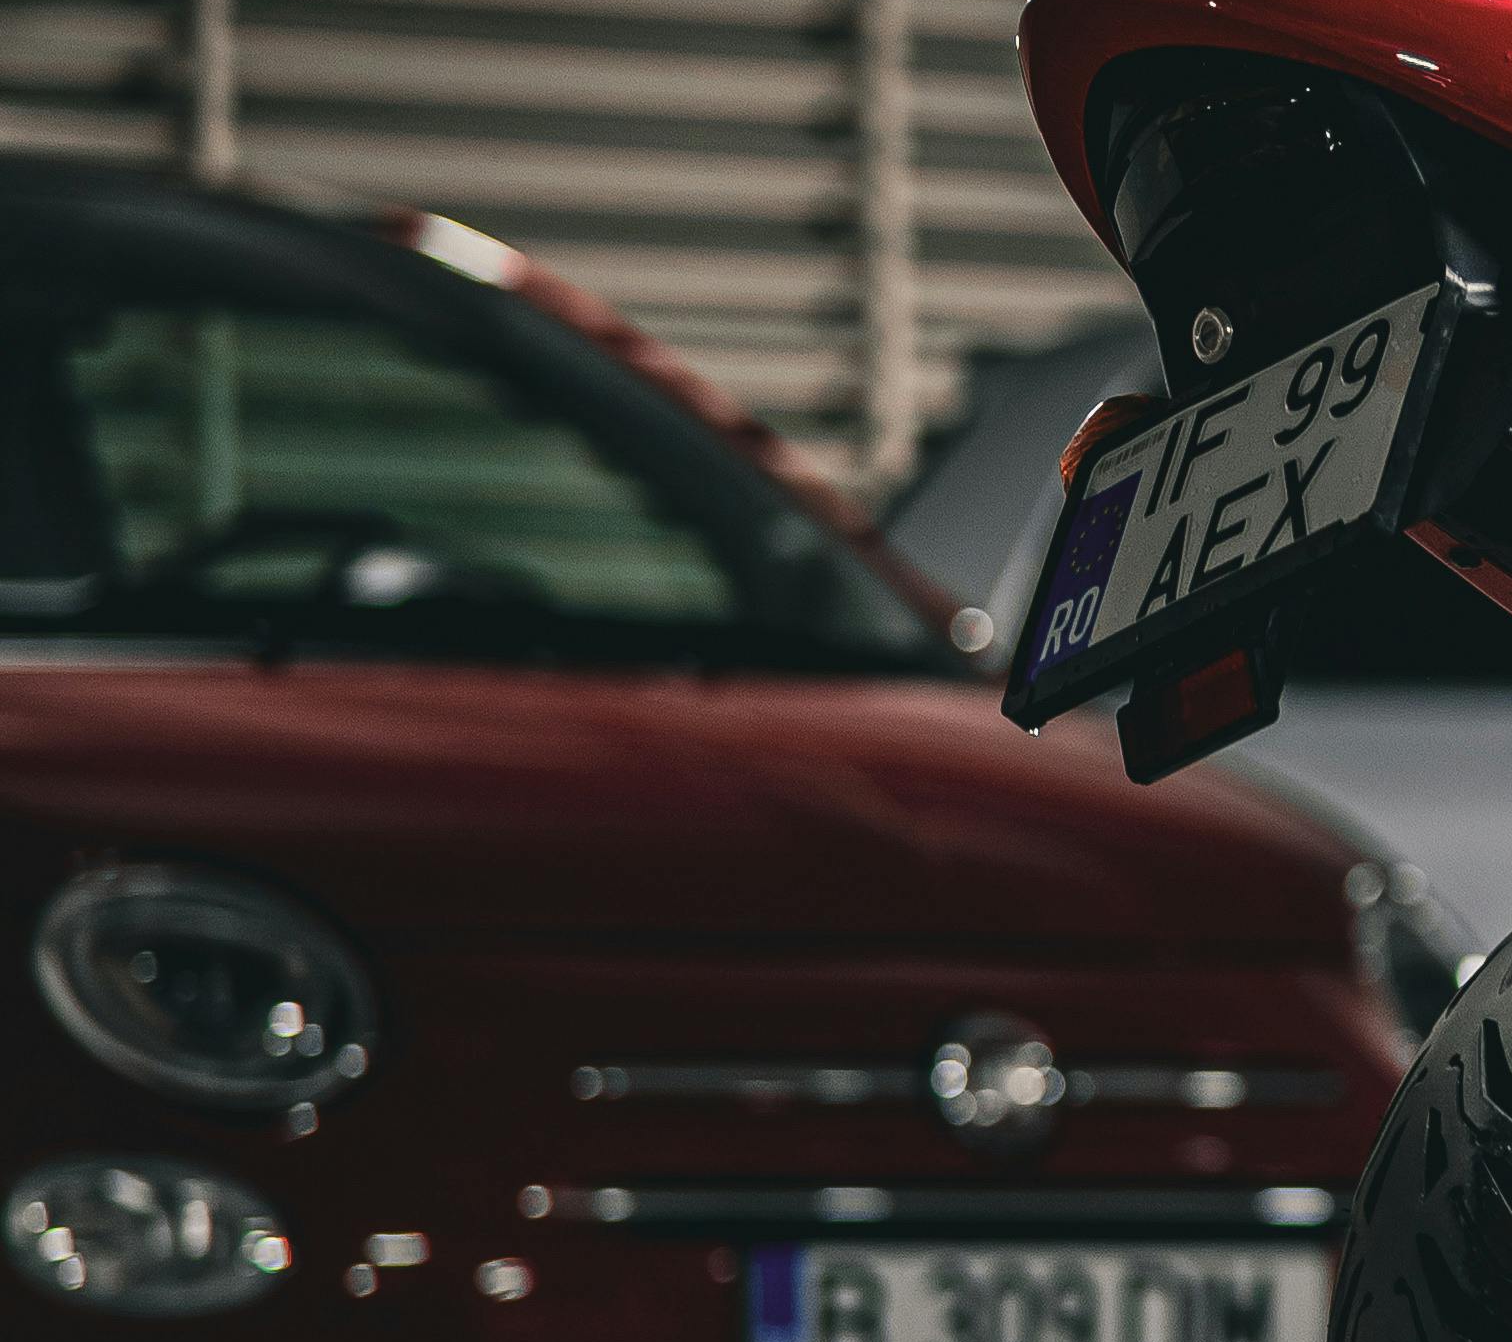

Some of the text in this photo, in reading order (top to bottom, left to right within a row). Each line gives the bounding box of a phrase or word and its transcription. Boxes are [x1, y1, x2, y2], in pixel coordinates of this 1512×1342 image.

[1143, 317, 1391, 519] IF 99
[1135, 436, 1338, 621] AEX
[1039, 585, 1101, 663] RO
